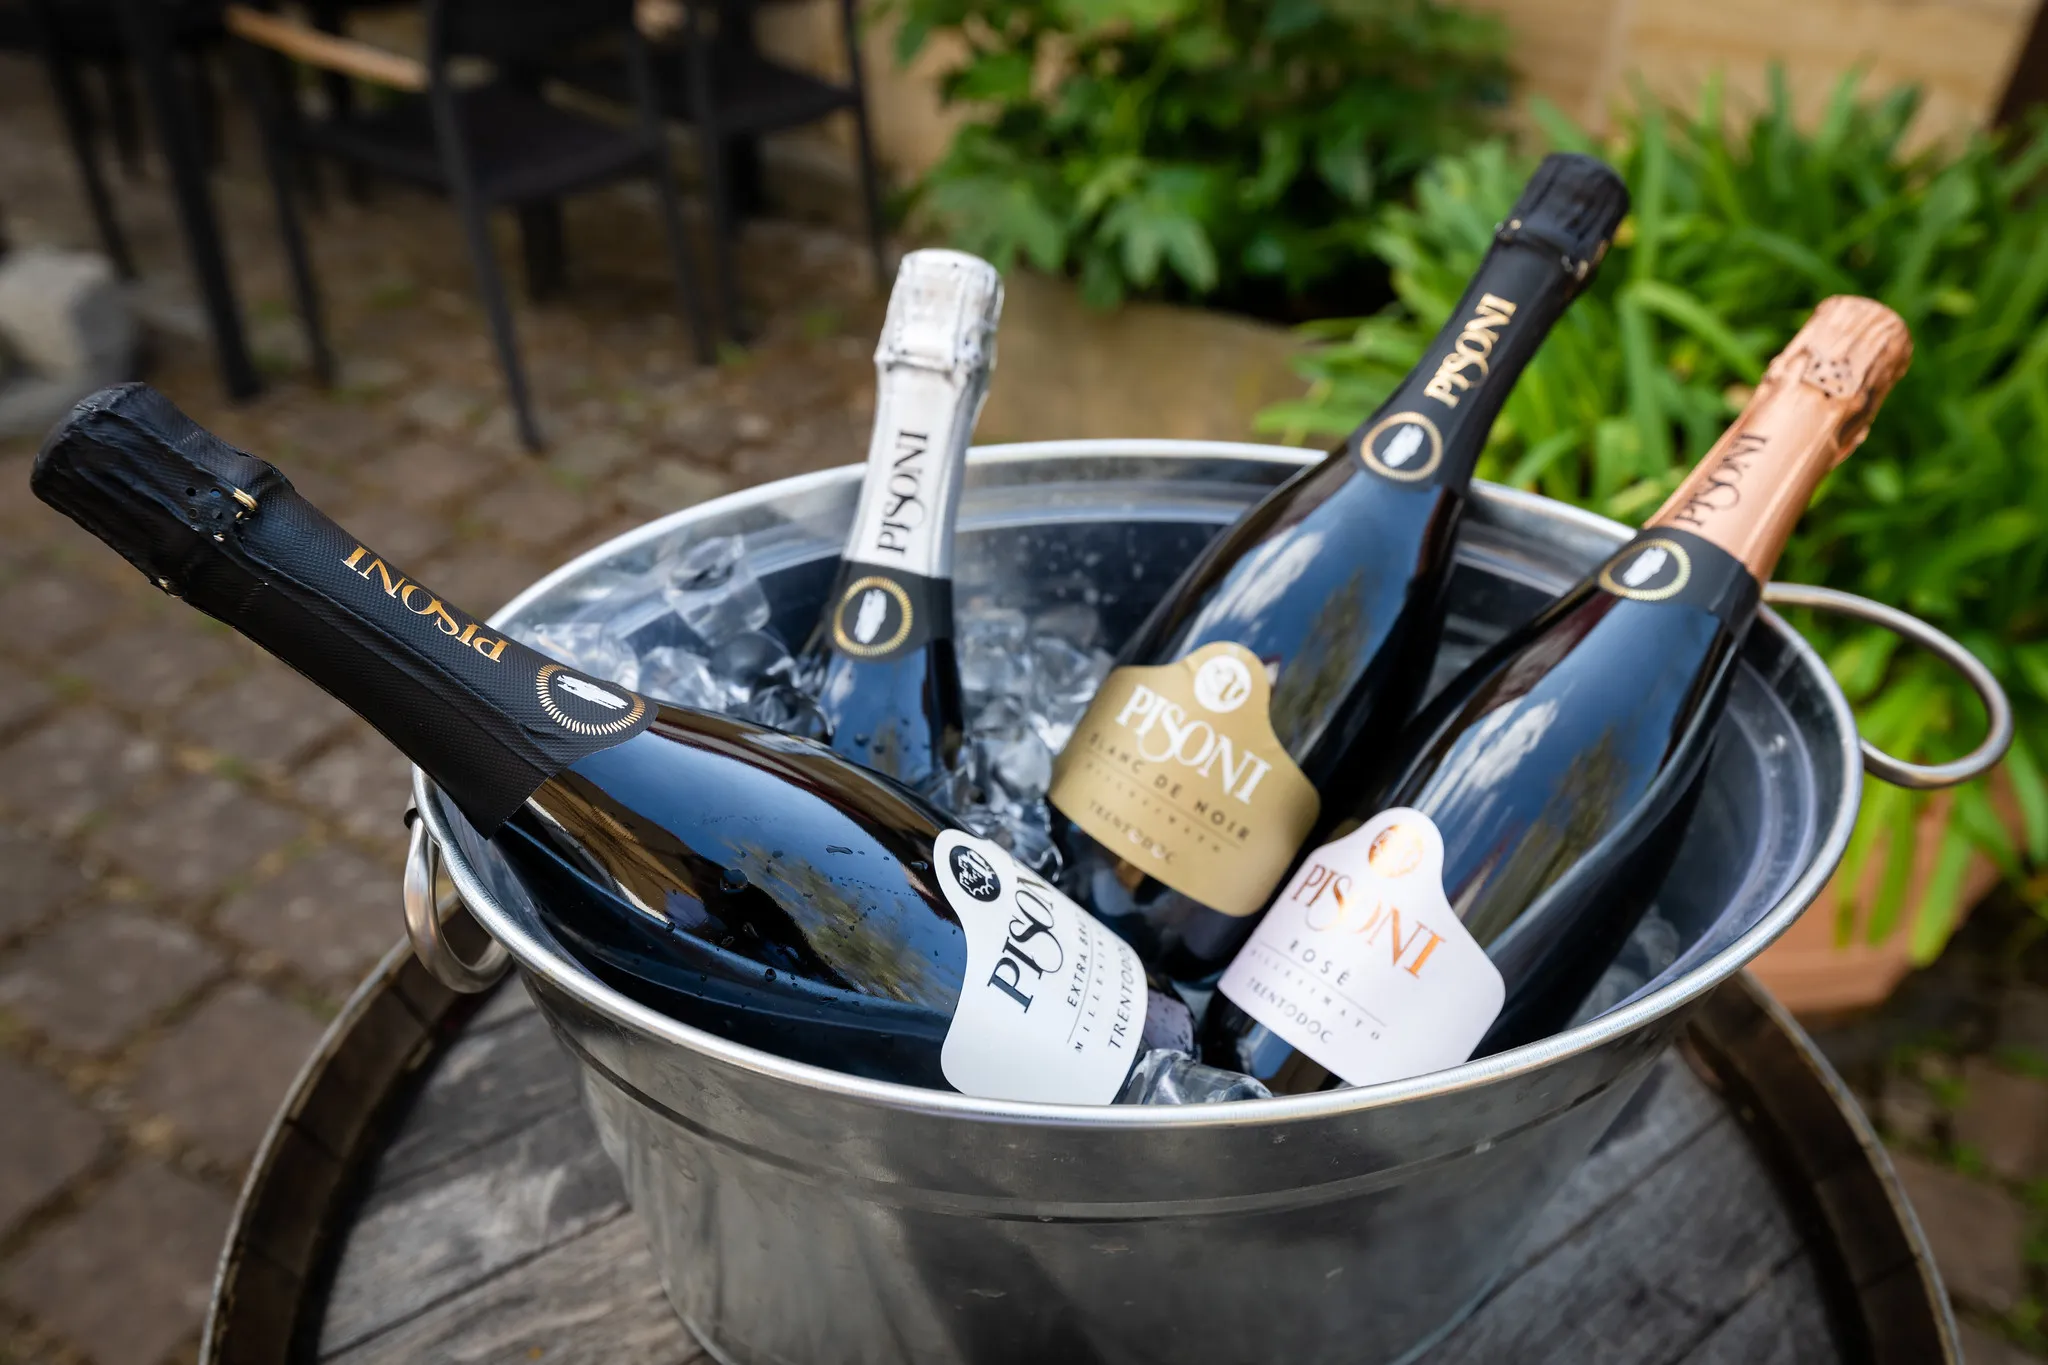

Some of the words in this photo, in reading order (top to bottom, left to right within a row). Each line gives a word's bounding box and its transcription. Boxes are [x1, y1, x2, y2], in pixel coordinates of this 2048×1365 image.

[1423, 292, 1517, 409] PISONI
[876, 429, 929, 556] PISONI
[1674, 432, 1769, 528] PISONI
[341, 544, 510, 663] PISONI
[1114, 683, 1272, 805] PISONI
[1154, 774, 1183, 799] DE
[1194, 801, 1250, 841] NOIR
[1067, 954, 1089, 1008] EXTRA
